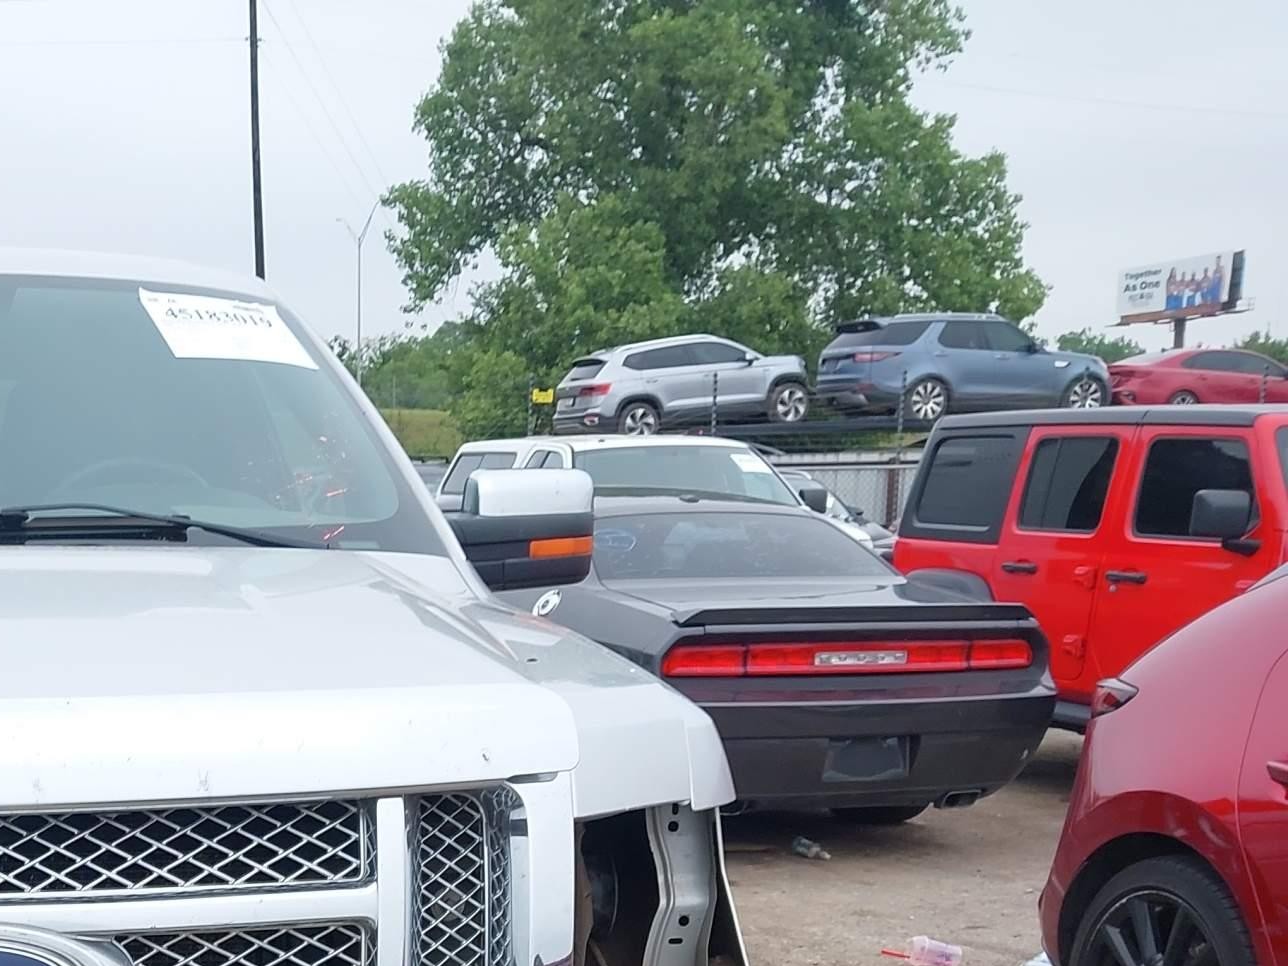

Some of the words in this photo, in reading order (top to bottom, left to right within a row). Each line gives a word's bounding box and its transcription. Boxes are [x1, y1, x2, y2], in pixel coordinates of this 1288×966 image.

[1124, 268, 1162, 281] Together
[1123, 282, 1138, 293] As
[1139, 280, 1161, 291] One
